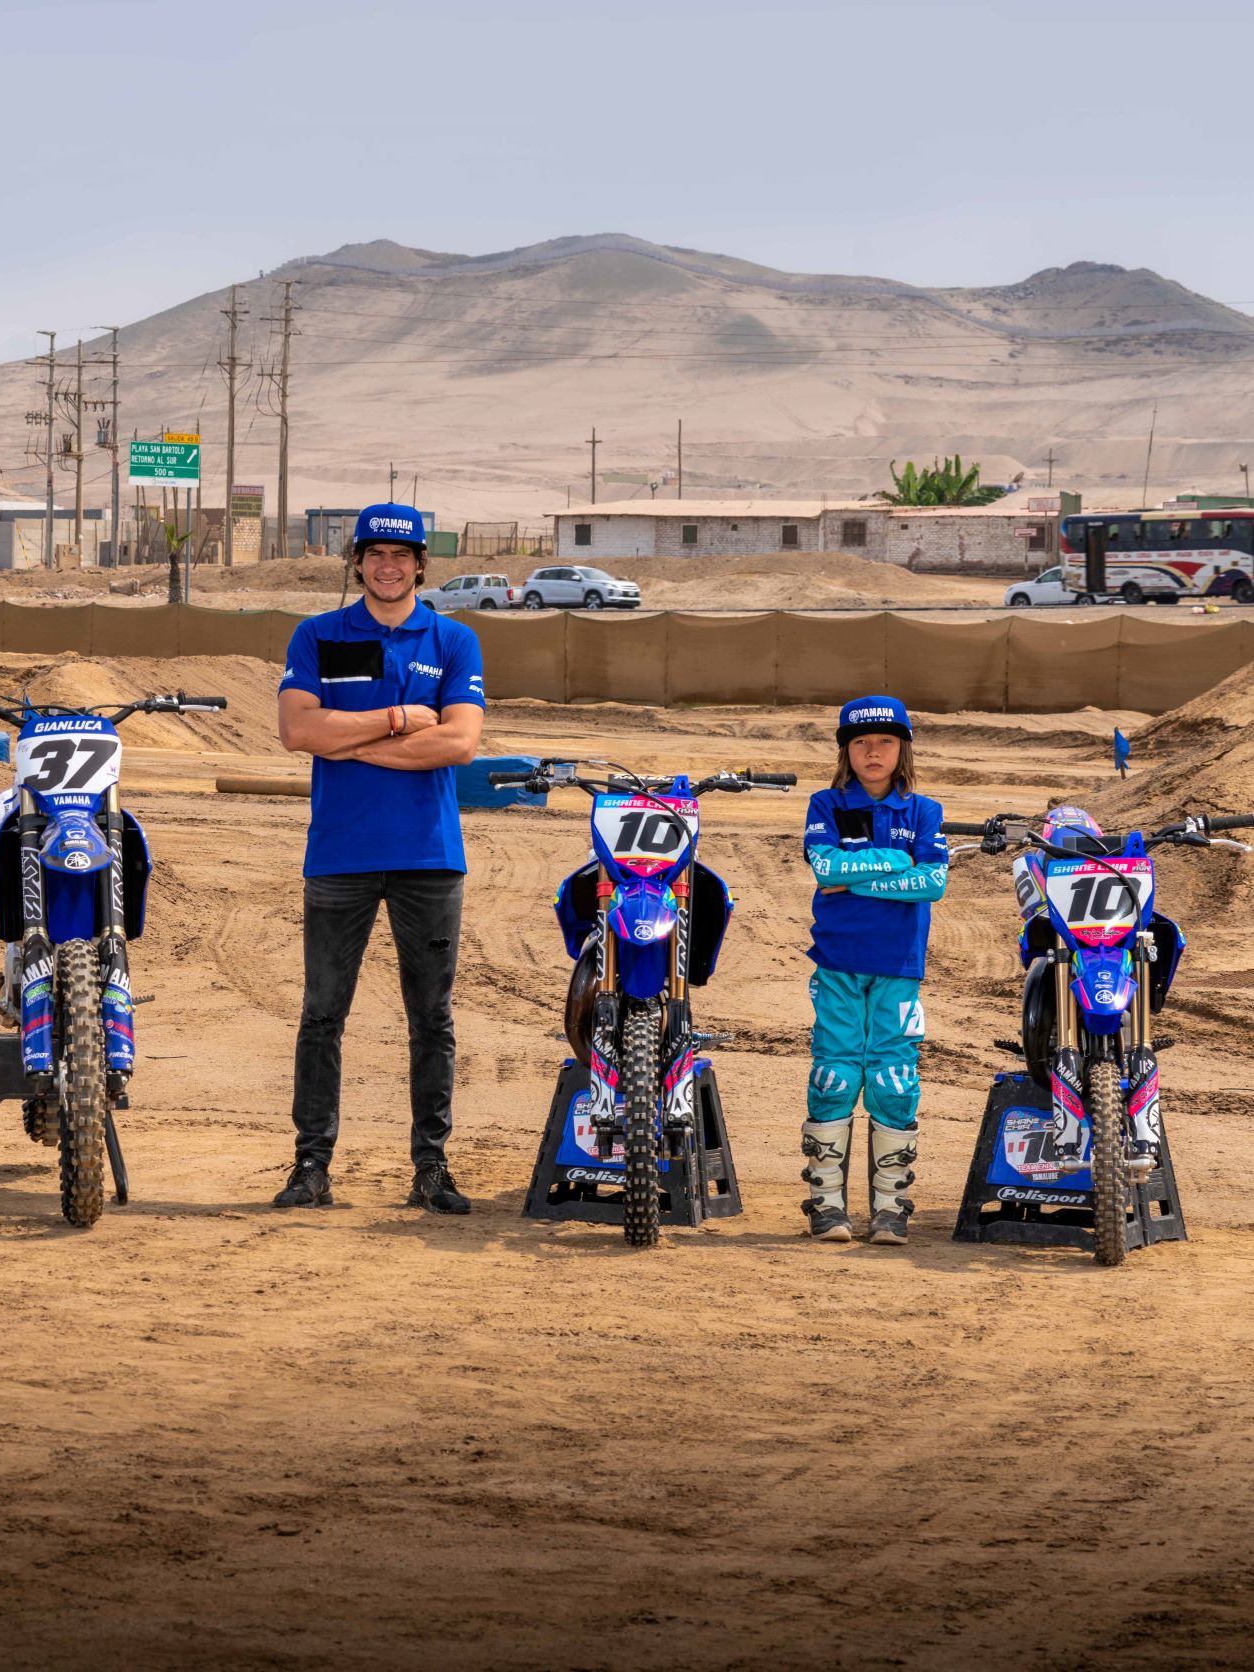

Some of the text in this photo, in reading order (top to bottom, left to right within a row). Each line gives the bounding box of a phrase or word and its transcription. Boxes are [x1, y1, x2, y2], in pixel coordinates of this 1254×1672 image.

[131, 444, 148, 453] PLAYA
[150, 445, 161, 453] SAN
[131, 455, 155, 463] RETORNO
[157, 456, 164, 464] AL
[154, 468, 166, 476] 500
[379, 518, 413, 530] YAMAHA
[858, 707, 894, 718] YAMAHA
[34, 720, 102, 733] GIANLUCA
[24, 738, 119, 792] 37
[53, 795, 91, 806] YAMAHA
[603, 799, 645, 807] SHANE
[614, 811, 688, 854] 10
[841, 861, 892, 874] RACING
[1053, 863, 1096, 873] SHANE
[21, 846, 43, 920] KYB
[870, 875, 928, 892] ANSWER
[1067, 876, 1142, 923] 10
[1056, 1061, 1084, 1095] YAMAHA
[571, 1168, 627, 1184] Polisp
[1001, 1187, 1087, 1204] Polisport
